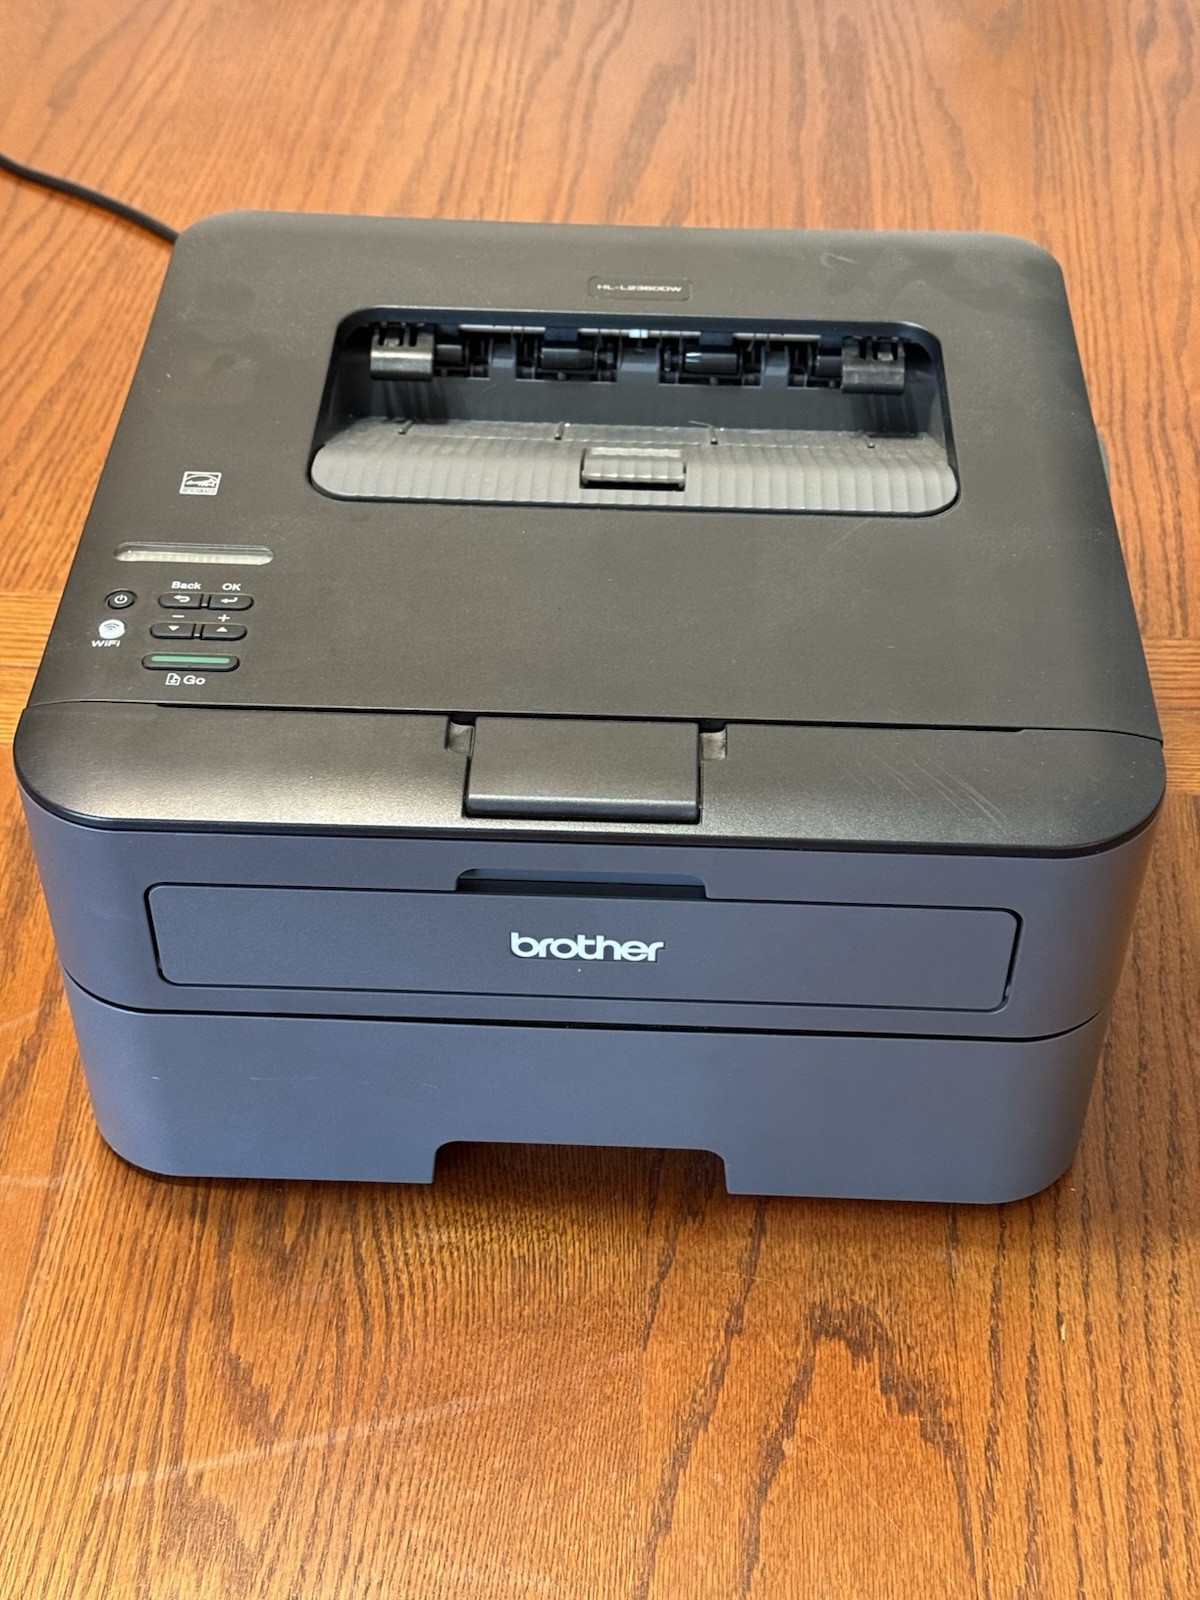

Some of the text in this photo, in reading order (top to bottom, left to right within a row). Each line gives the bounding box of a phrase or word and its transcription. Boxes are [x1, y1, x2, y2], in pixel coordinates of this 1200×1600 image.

[171, 581, 201, 590] Back
[222, 583, 242, 591] OK
[183, 674, 206, 685] Go
[510, 932, 664, 962] brother
